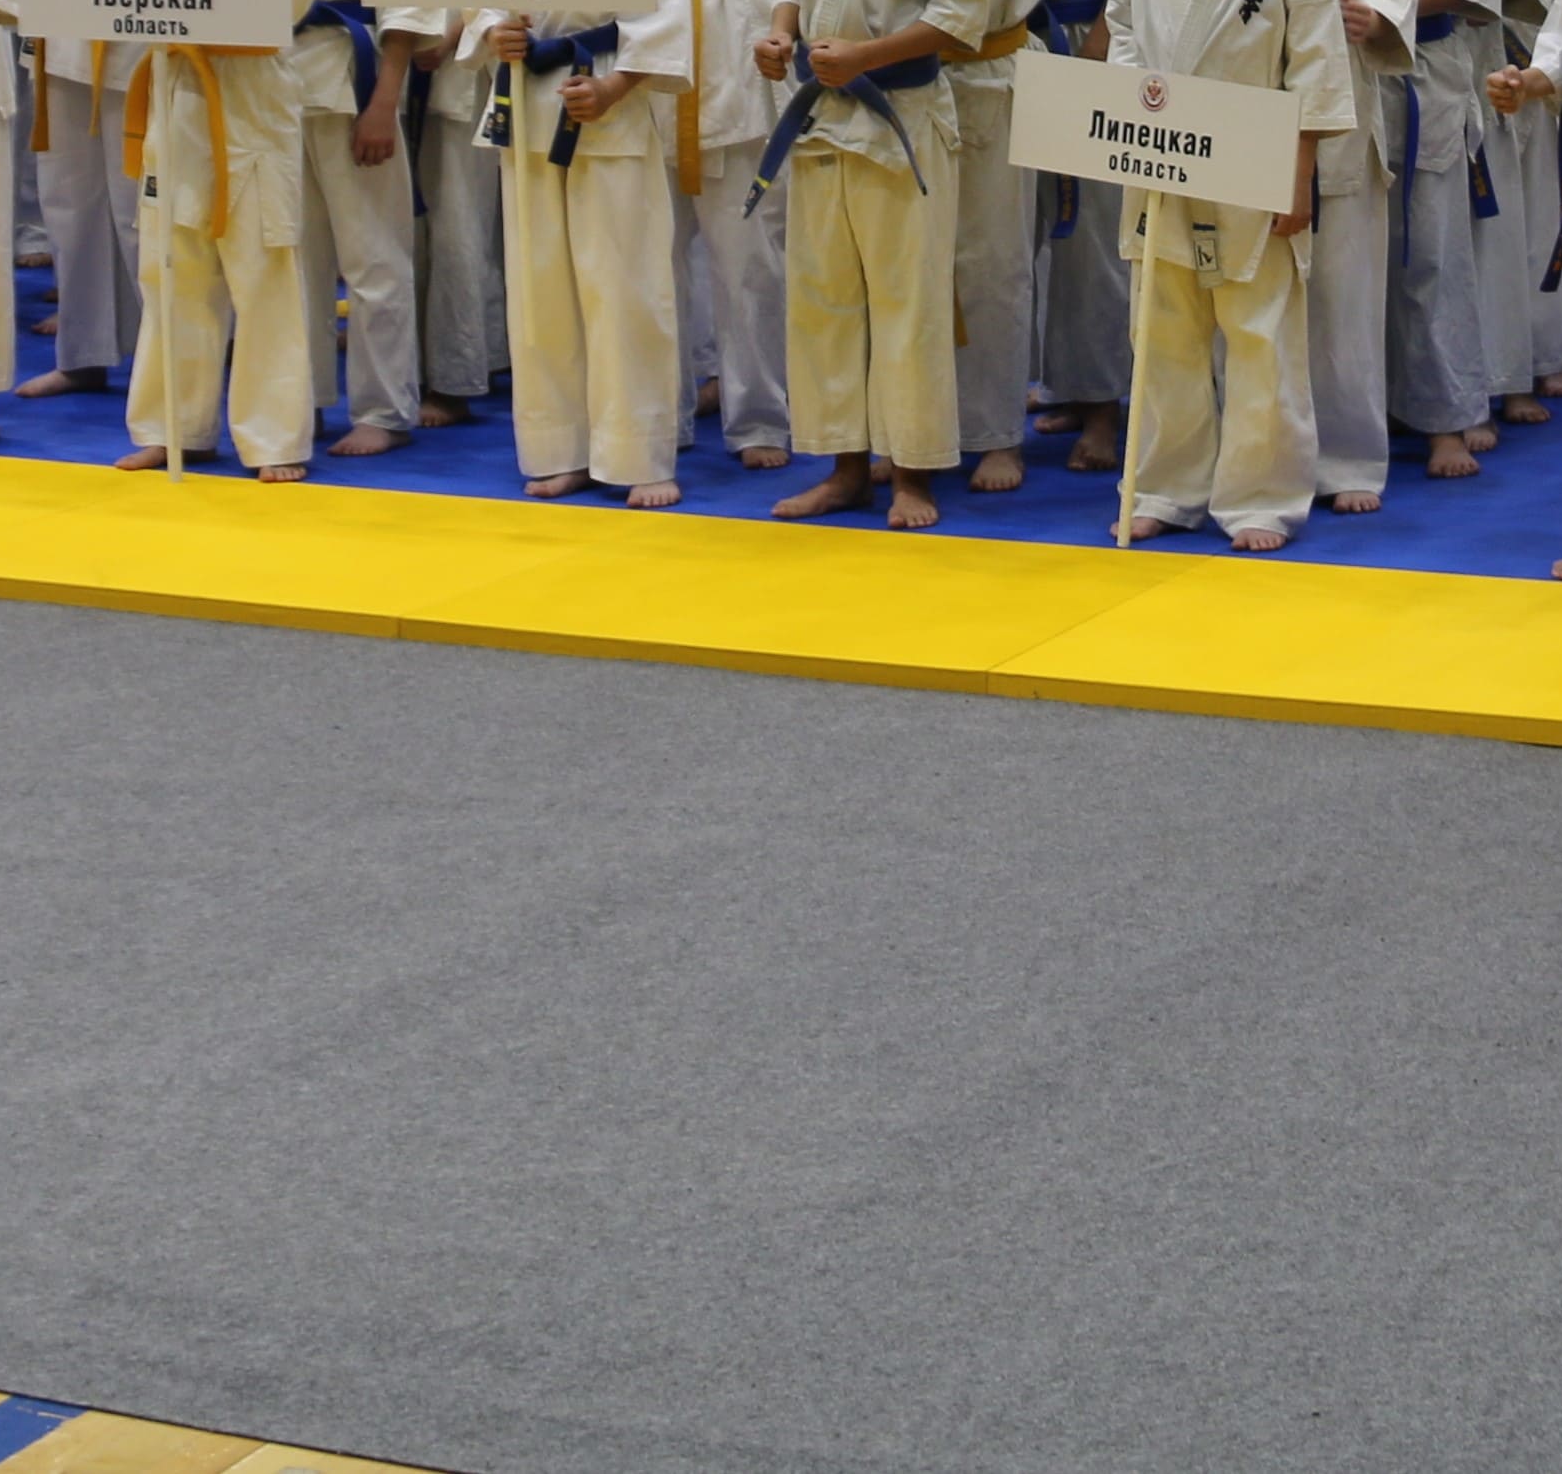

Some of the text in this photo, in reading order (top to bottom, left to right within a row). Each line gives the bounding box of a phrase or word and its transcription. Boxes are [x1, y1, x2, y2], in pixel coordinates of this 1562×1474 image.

[113, 15, 188, 36] область
[1089, 109, 1213, 158] Липецкая
[1108, 152, 1188, 183] область
